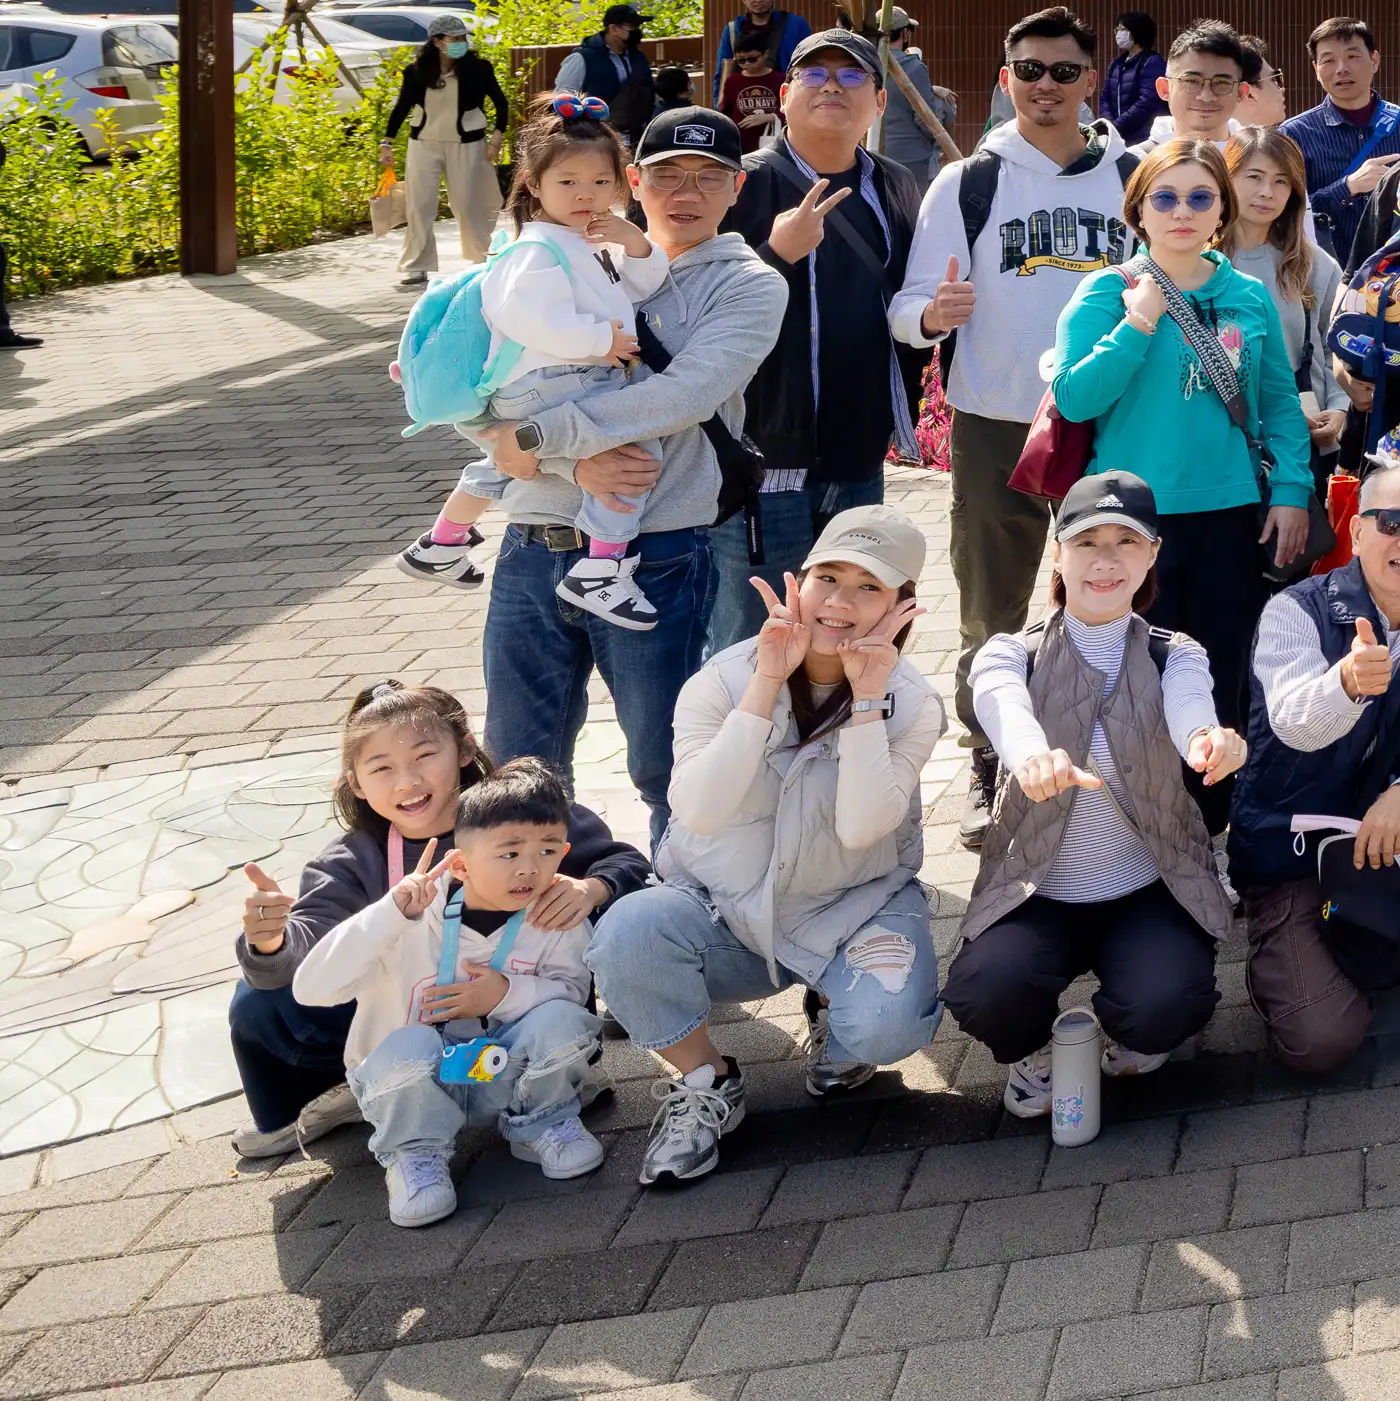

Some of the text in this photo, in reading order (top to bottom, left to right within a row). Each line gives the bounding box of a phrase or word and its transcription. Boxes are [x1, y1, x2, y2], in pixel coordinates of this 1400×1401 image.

[739, 99, 775, 109] OLD NAVY
[999, 206, 1127, 274] ROOTS
